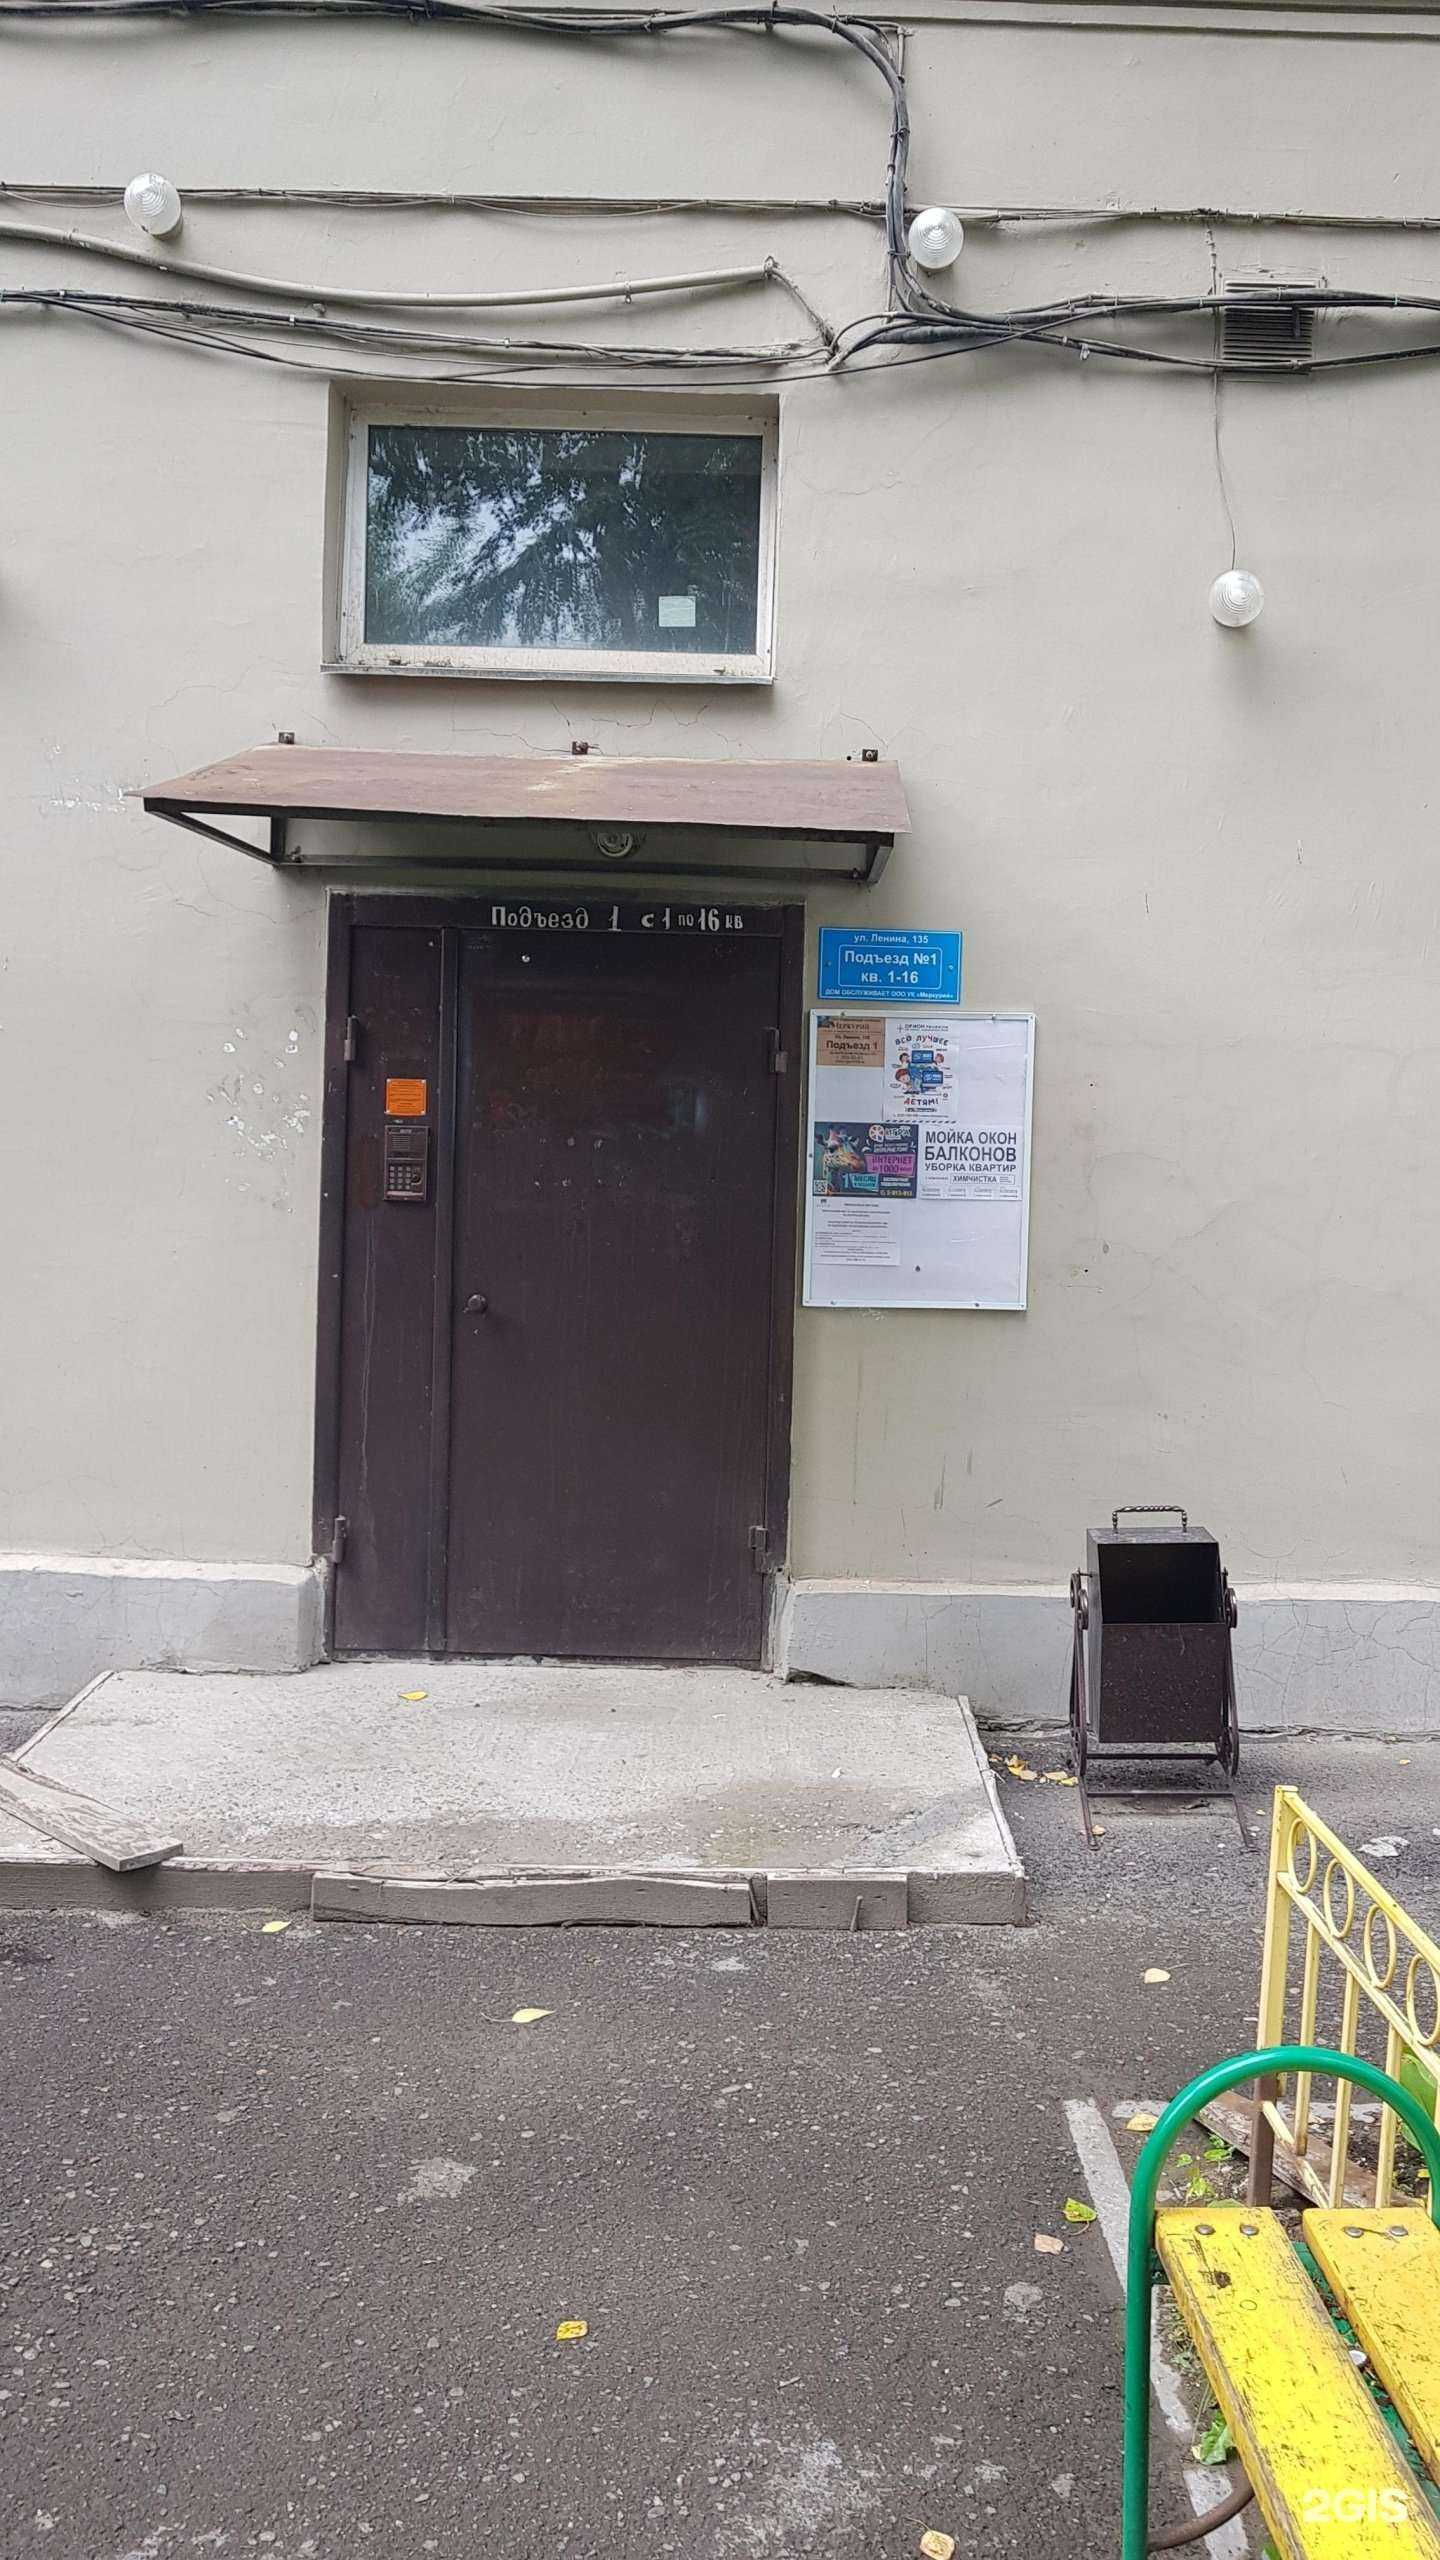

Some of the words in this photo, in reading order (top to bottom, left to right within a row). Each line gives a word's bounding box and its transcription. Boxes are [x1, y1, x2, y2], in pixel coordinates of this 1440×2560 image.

[491, 906, 589, 929] Подъезд
[607, 905, 622, 931] 1
[661, 907, 671, 930] 1
[678, 913, 694, 928] по
[697, 908, 720, 932] 16
[725, 914, 743, 930] кв
[854, 934, 868, 944] ул.
[912, 935, 928, 944] 135
[844, 950, 909, 966] Подъезд
[913, 952, 937, 966] №1
[860, 972, 882, 983] кв.
[887, 970, 919, 984] 1-16
[826, 1040, 871, 1051] Подъезд
[925, 1128, 974, 1144] МОЙКА
[978, 1132, 1017, 1145] ОКОН
[925, 1145, 1017, 1162] БАЛКОНОВ
[924, 1162, 966, 1172] УБОРКА
[968, 1163, 1016, 1173] КВАРТИР
[952, 1175, 997, 1183] ХИМЧИСТКА
